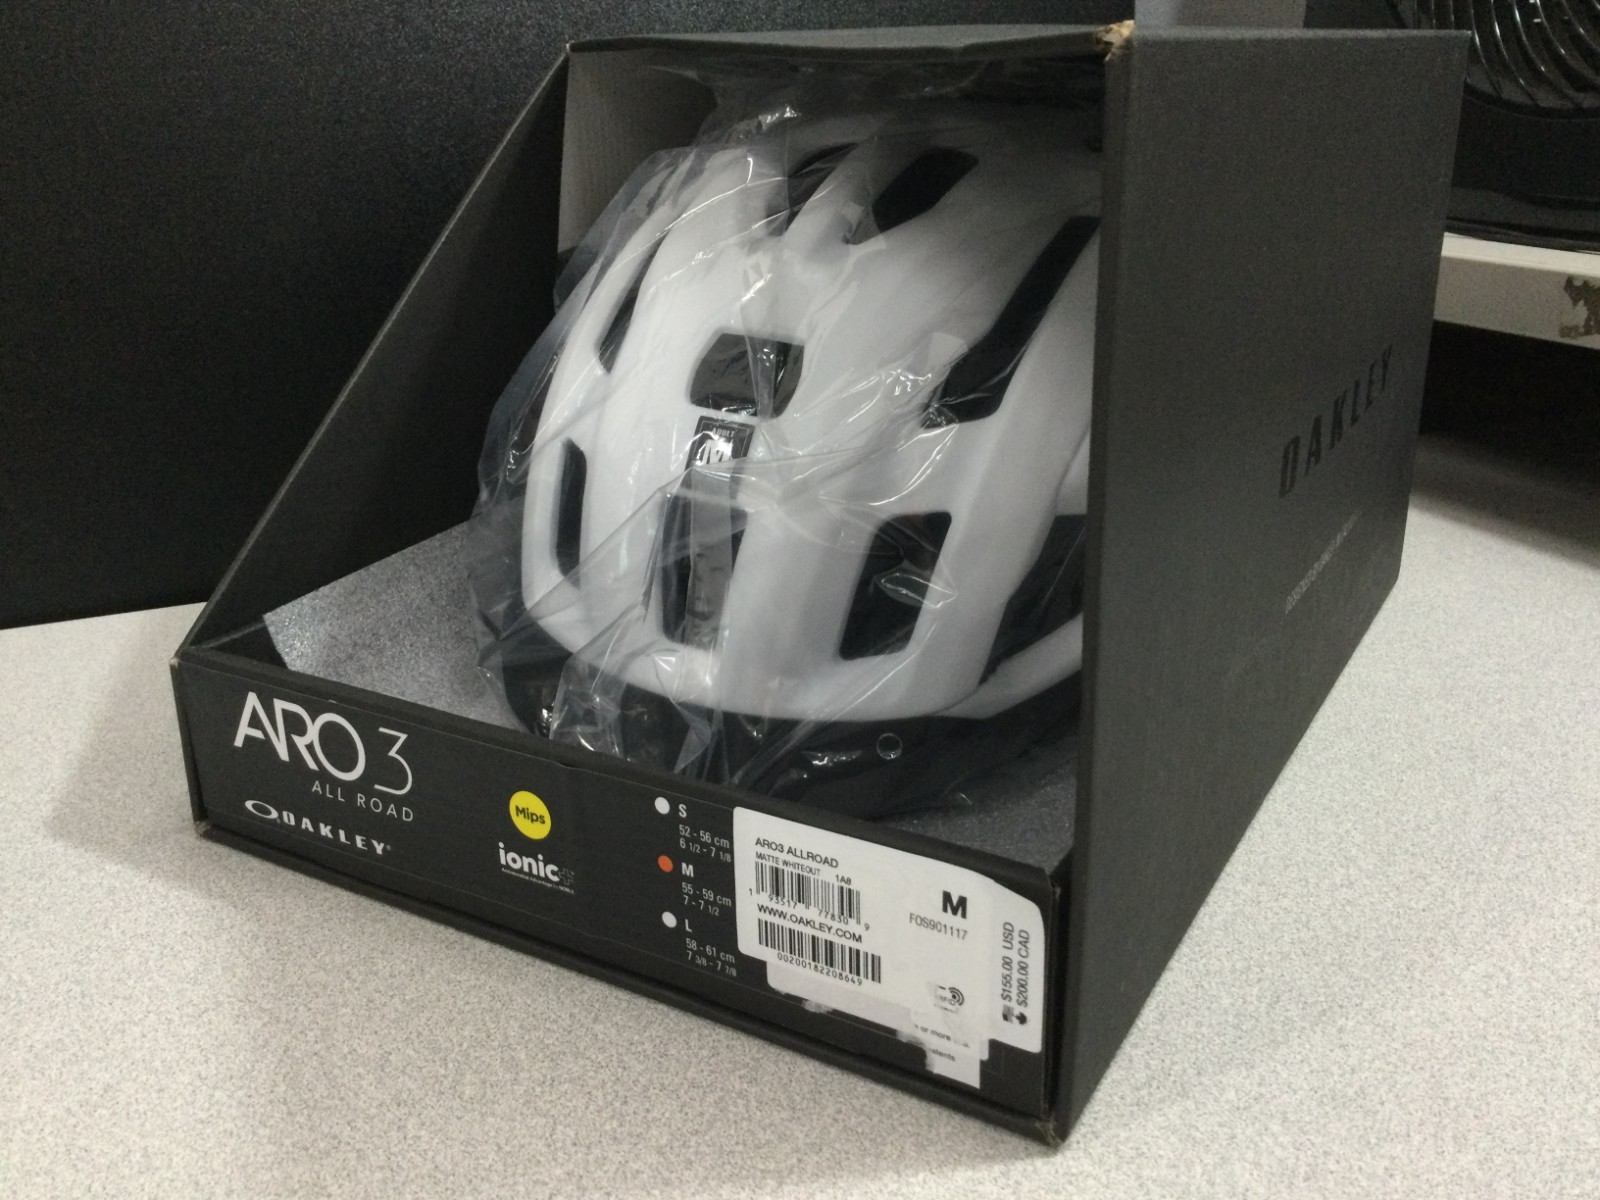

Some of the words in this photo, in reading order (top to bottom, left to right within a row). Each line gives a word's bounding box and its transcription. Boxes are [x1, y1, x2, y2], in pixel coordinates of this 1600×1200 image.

[1279, 344, 1393, 499] OAKLEY
[234, 691, 366, 782] ARO
[374, 727, 413, 795] 3
[312, 780, 345, 802] ALL
[357, 793, 414, 822] ROAD
[515, 805, 546, 825] Mips
[678, 803, 688, 819] S
[679, 824, 691, 838] 52
[700, 830, 712, 843] 56
[714, 837, 730, 849] cm
[680, 837, 686, 849] 6
[689, 842, 700, 854] 1/2
[710, 846, 716, 858] 7
[755, 837, 785, 853] ARO3
[786, 846, 839, 869] ALLROAD
[681, 862, 694, 878] M
[756, 851, 780, 866] MATTE
[782, 859, 820, 876] WHITEOUT
[836, 873, 852, 886] 1A8
[682, 881, 693, 895] 55
[702, 888, 714, 901] 59
[716, 895, 732, 907] cm
[683, 894, 689, 905] 7
[698, 899, 704, 910] 7
[708, 904, 720, 917] 1/2
[942, 889, 968, 920] M
[684, 918, 693, 933] L
[757, 903, 863, 944] WWW.OAKLEY.COM
[864, 922, 870, 932] 9
[1002, 921, 1015, 951] USD
[686, 937, 697, 950] 58
[706, 944, 717, 958] 61
[720, 952, 736, 964] cm
[1018, 929, 1030, 959] CAD
[686, 949, 692, 961] 7
[716, 960, 722, 971] 7
[1001, 956, 1014, 1003] $155.00
[1016, 960, 1029, 1008] $200.00
